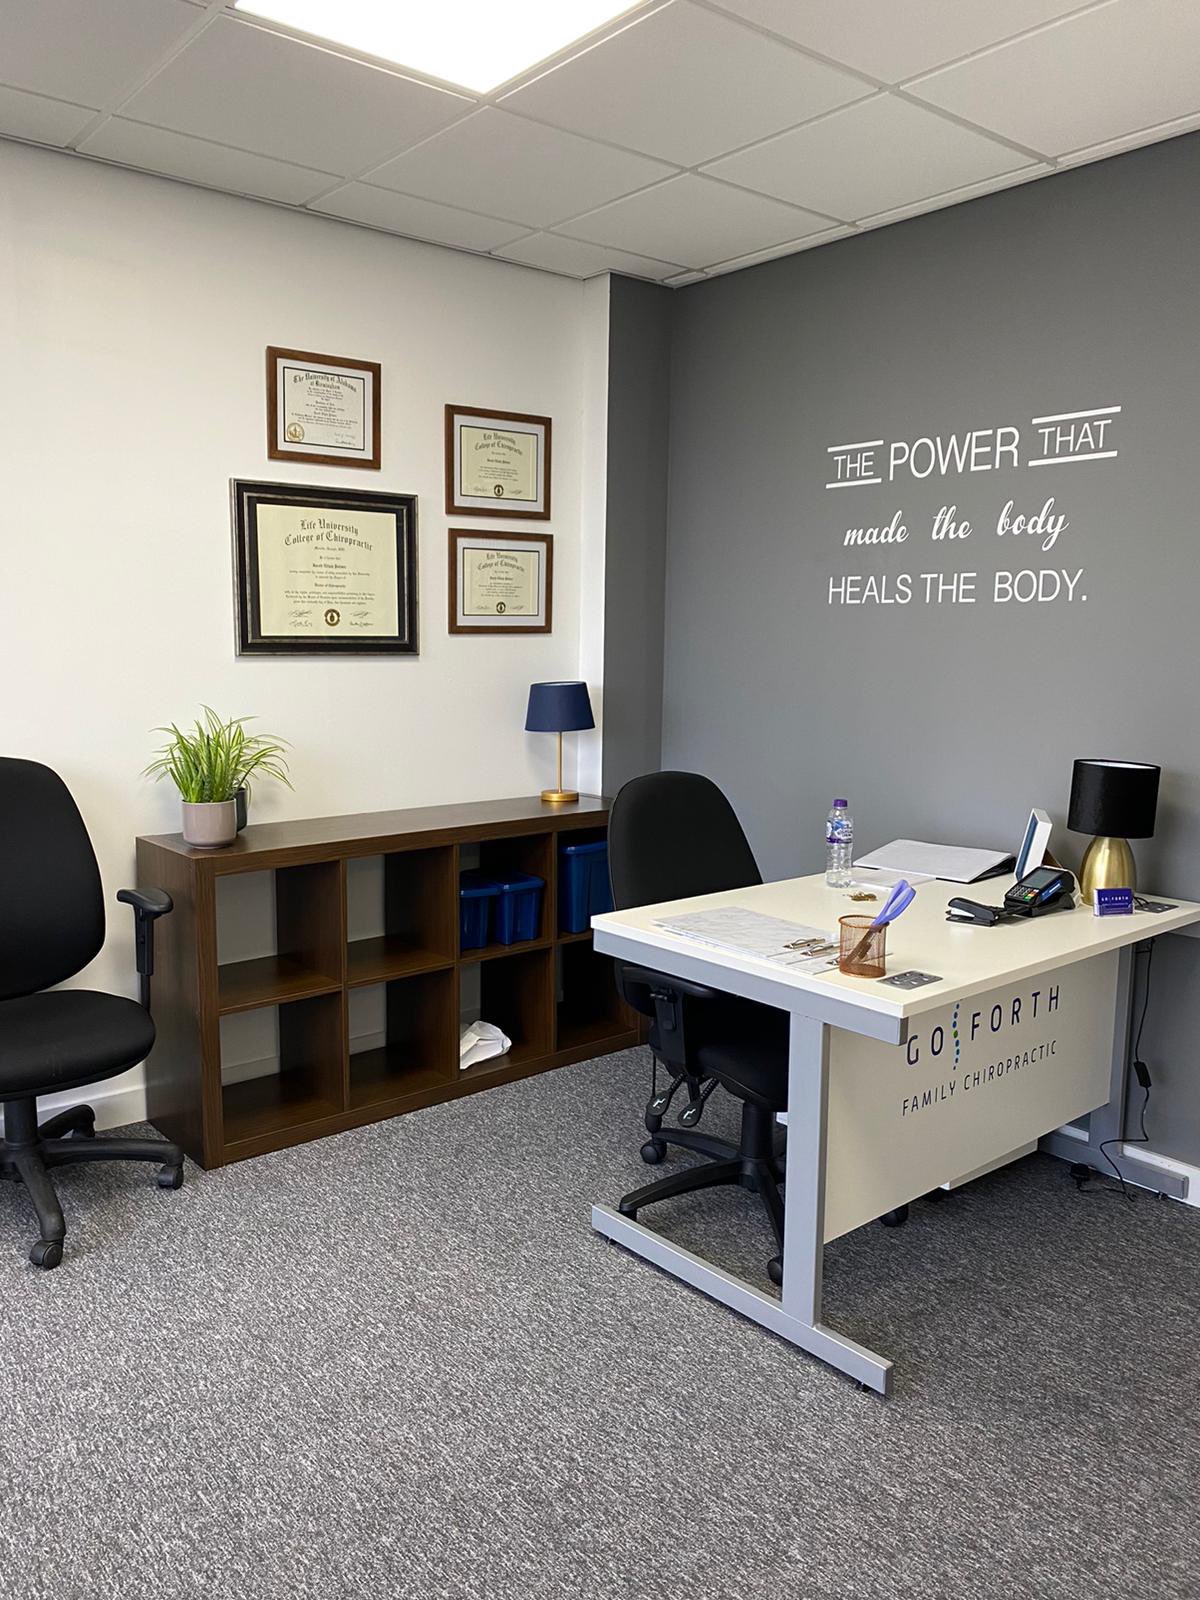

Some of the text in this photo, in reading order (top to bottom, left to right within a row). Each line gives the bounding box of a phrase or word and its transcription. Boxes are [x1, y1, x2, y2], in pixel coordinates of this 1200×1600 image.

[833, 419, 1112, 481] THE POWER THAT
[284, 533, 314, 546] College
[316, 532, 324, 541] of
[325, 530, 373, 551] Chiropractic
[300, 518, 359, 536] Life University
[843, 497, 1070, 551] made the body
[828, 568, 1087, 604] HEALS THE BODY.
[906, 985, 1060, 1066] GO FORTH
[902, 1040, 1057, 1116] FAMILY CHIROPRACTIC
